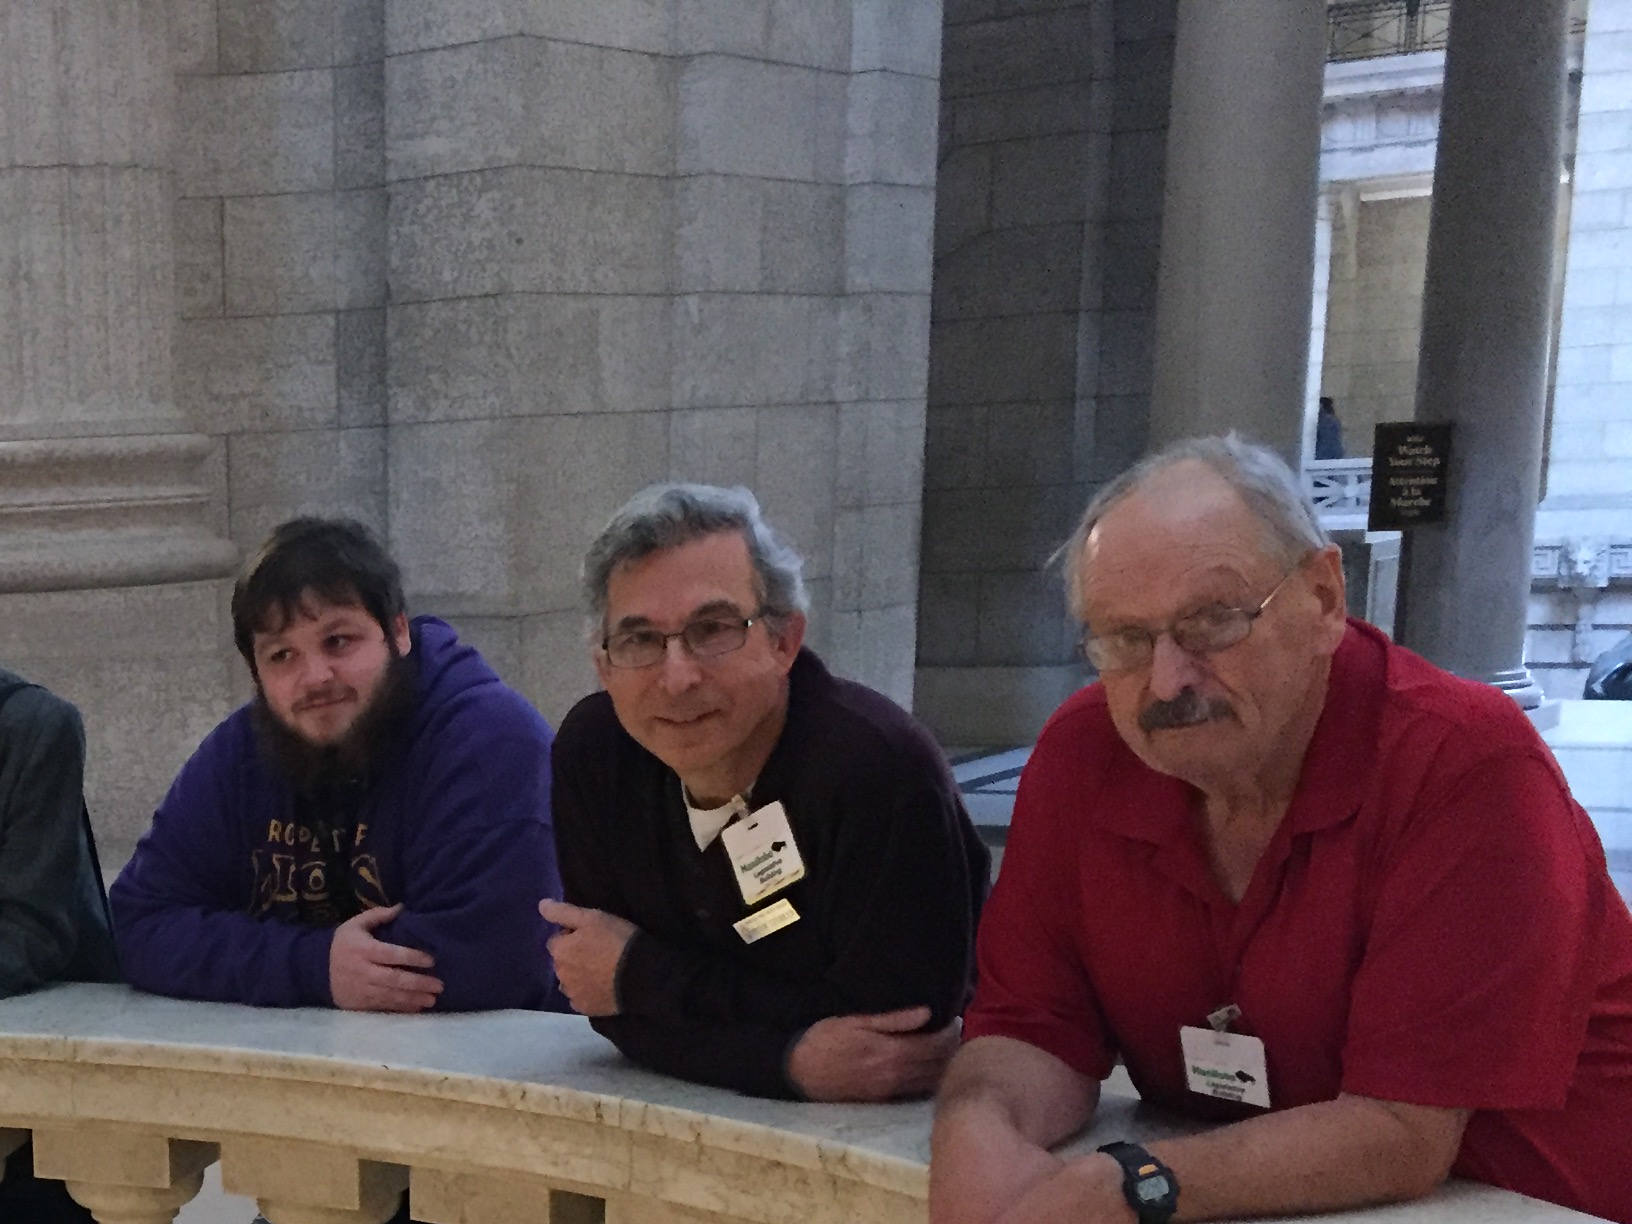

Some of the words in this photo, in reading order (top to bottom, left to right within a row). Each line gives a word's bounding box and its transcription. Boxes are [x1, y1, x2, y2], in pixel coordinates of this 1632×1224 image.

[1398, 444, 1432, 456] Watch
[1415, 456, 1441, 467] Step
[1388, 476, 1439, 486] Attention
[740, 850, 774, 873] Manitoba
